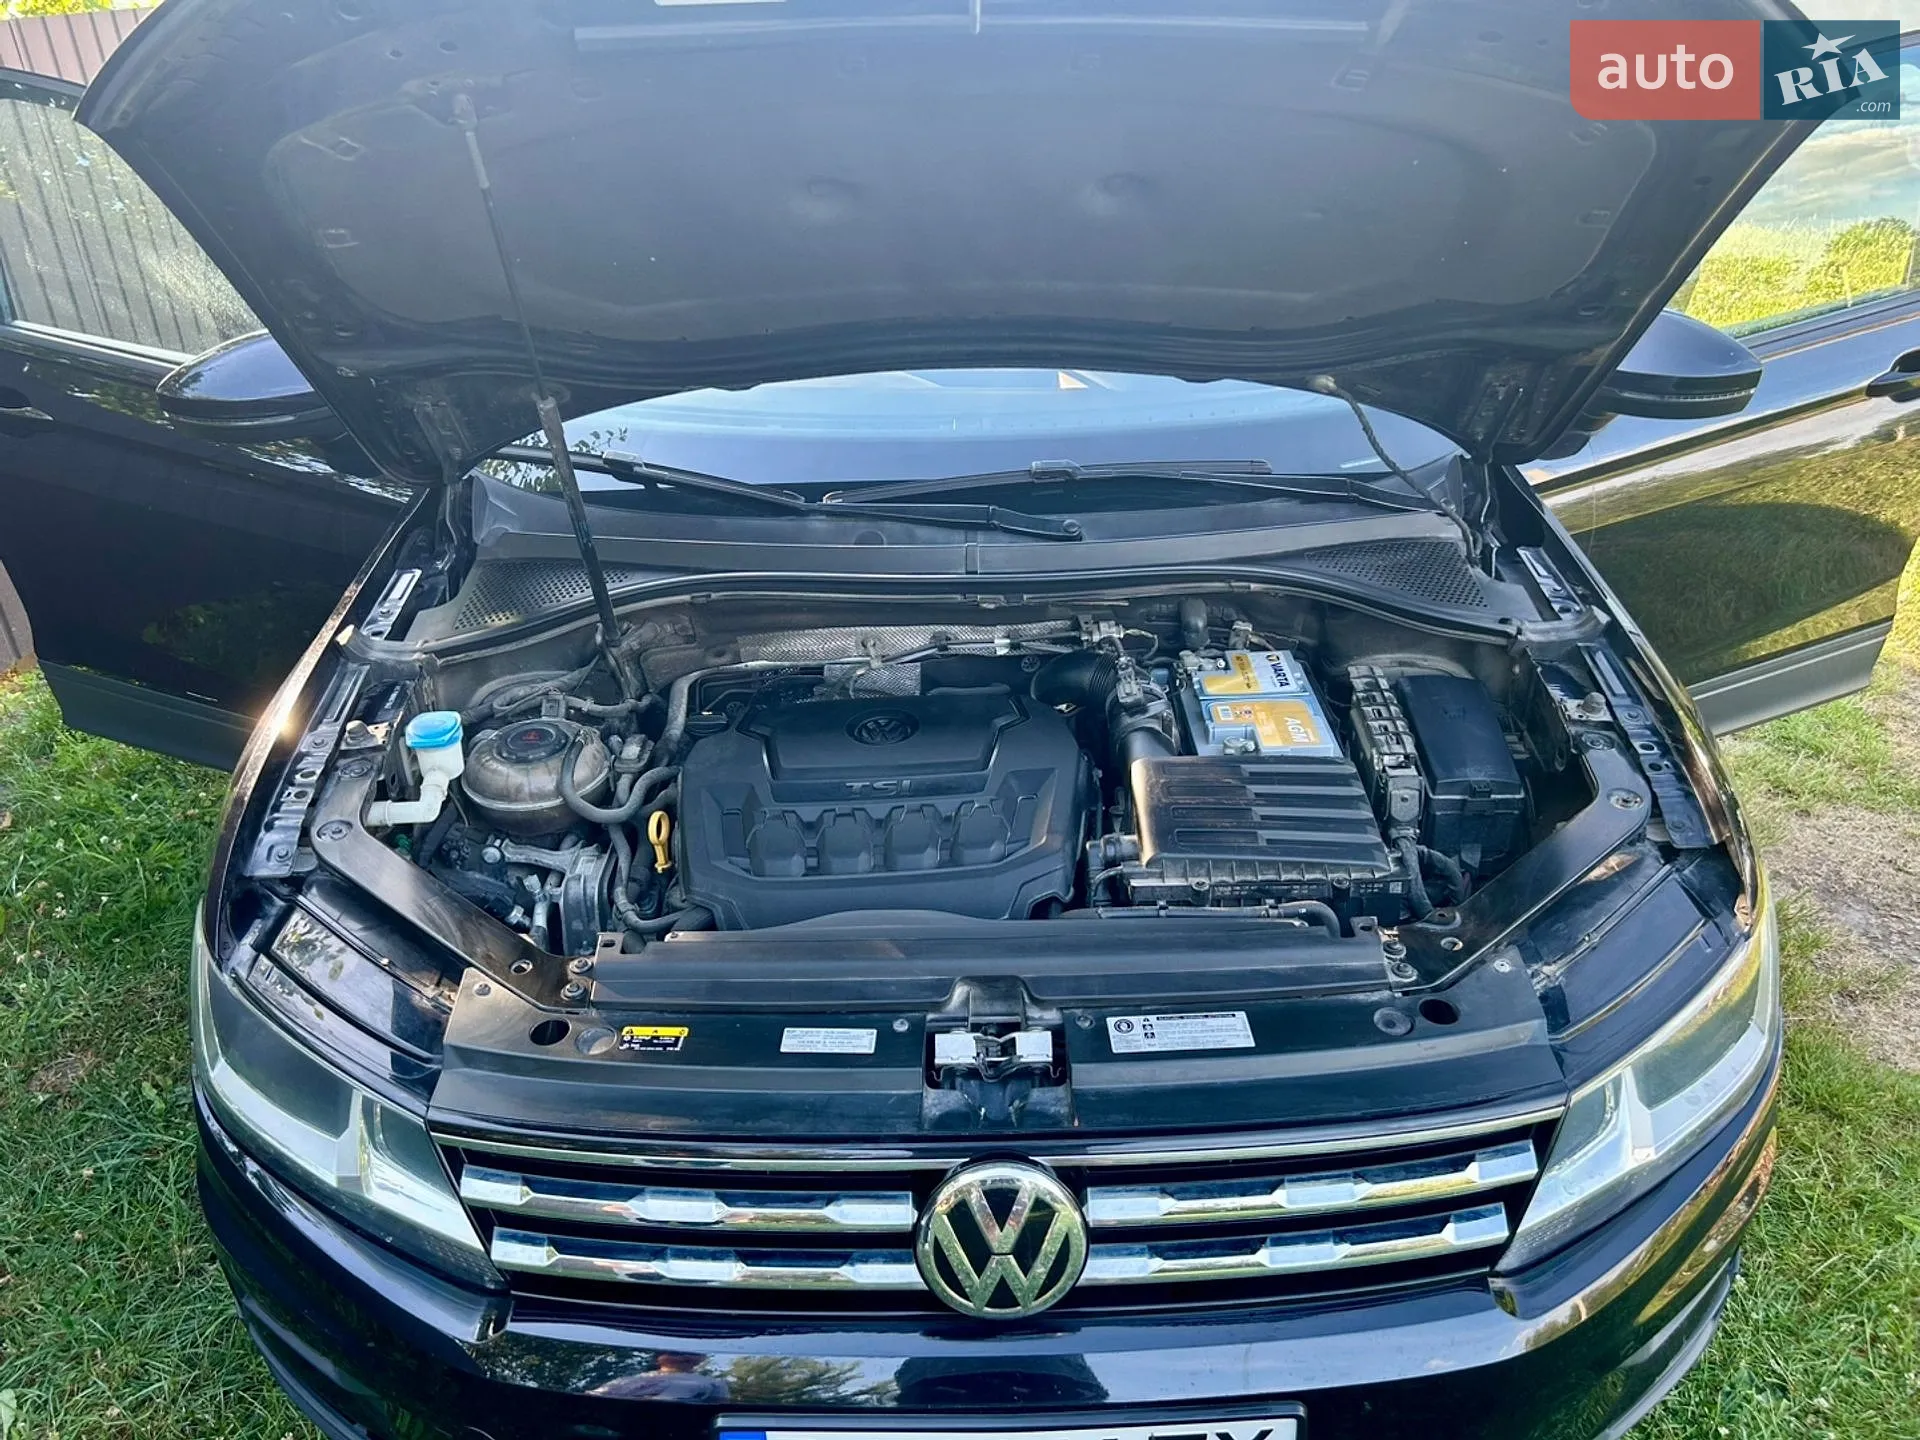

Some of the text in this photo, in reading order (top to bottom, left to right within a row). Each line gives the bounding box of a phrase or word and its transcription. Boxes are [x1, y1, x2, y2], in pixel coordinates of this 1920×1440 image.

[1270, 662, 1290, 687] VARTA
[1284, 717, 1310, 743] AGM
[845, 779, 912, 798] TSI
